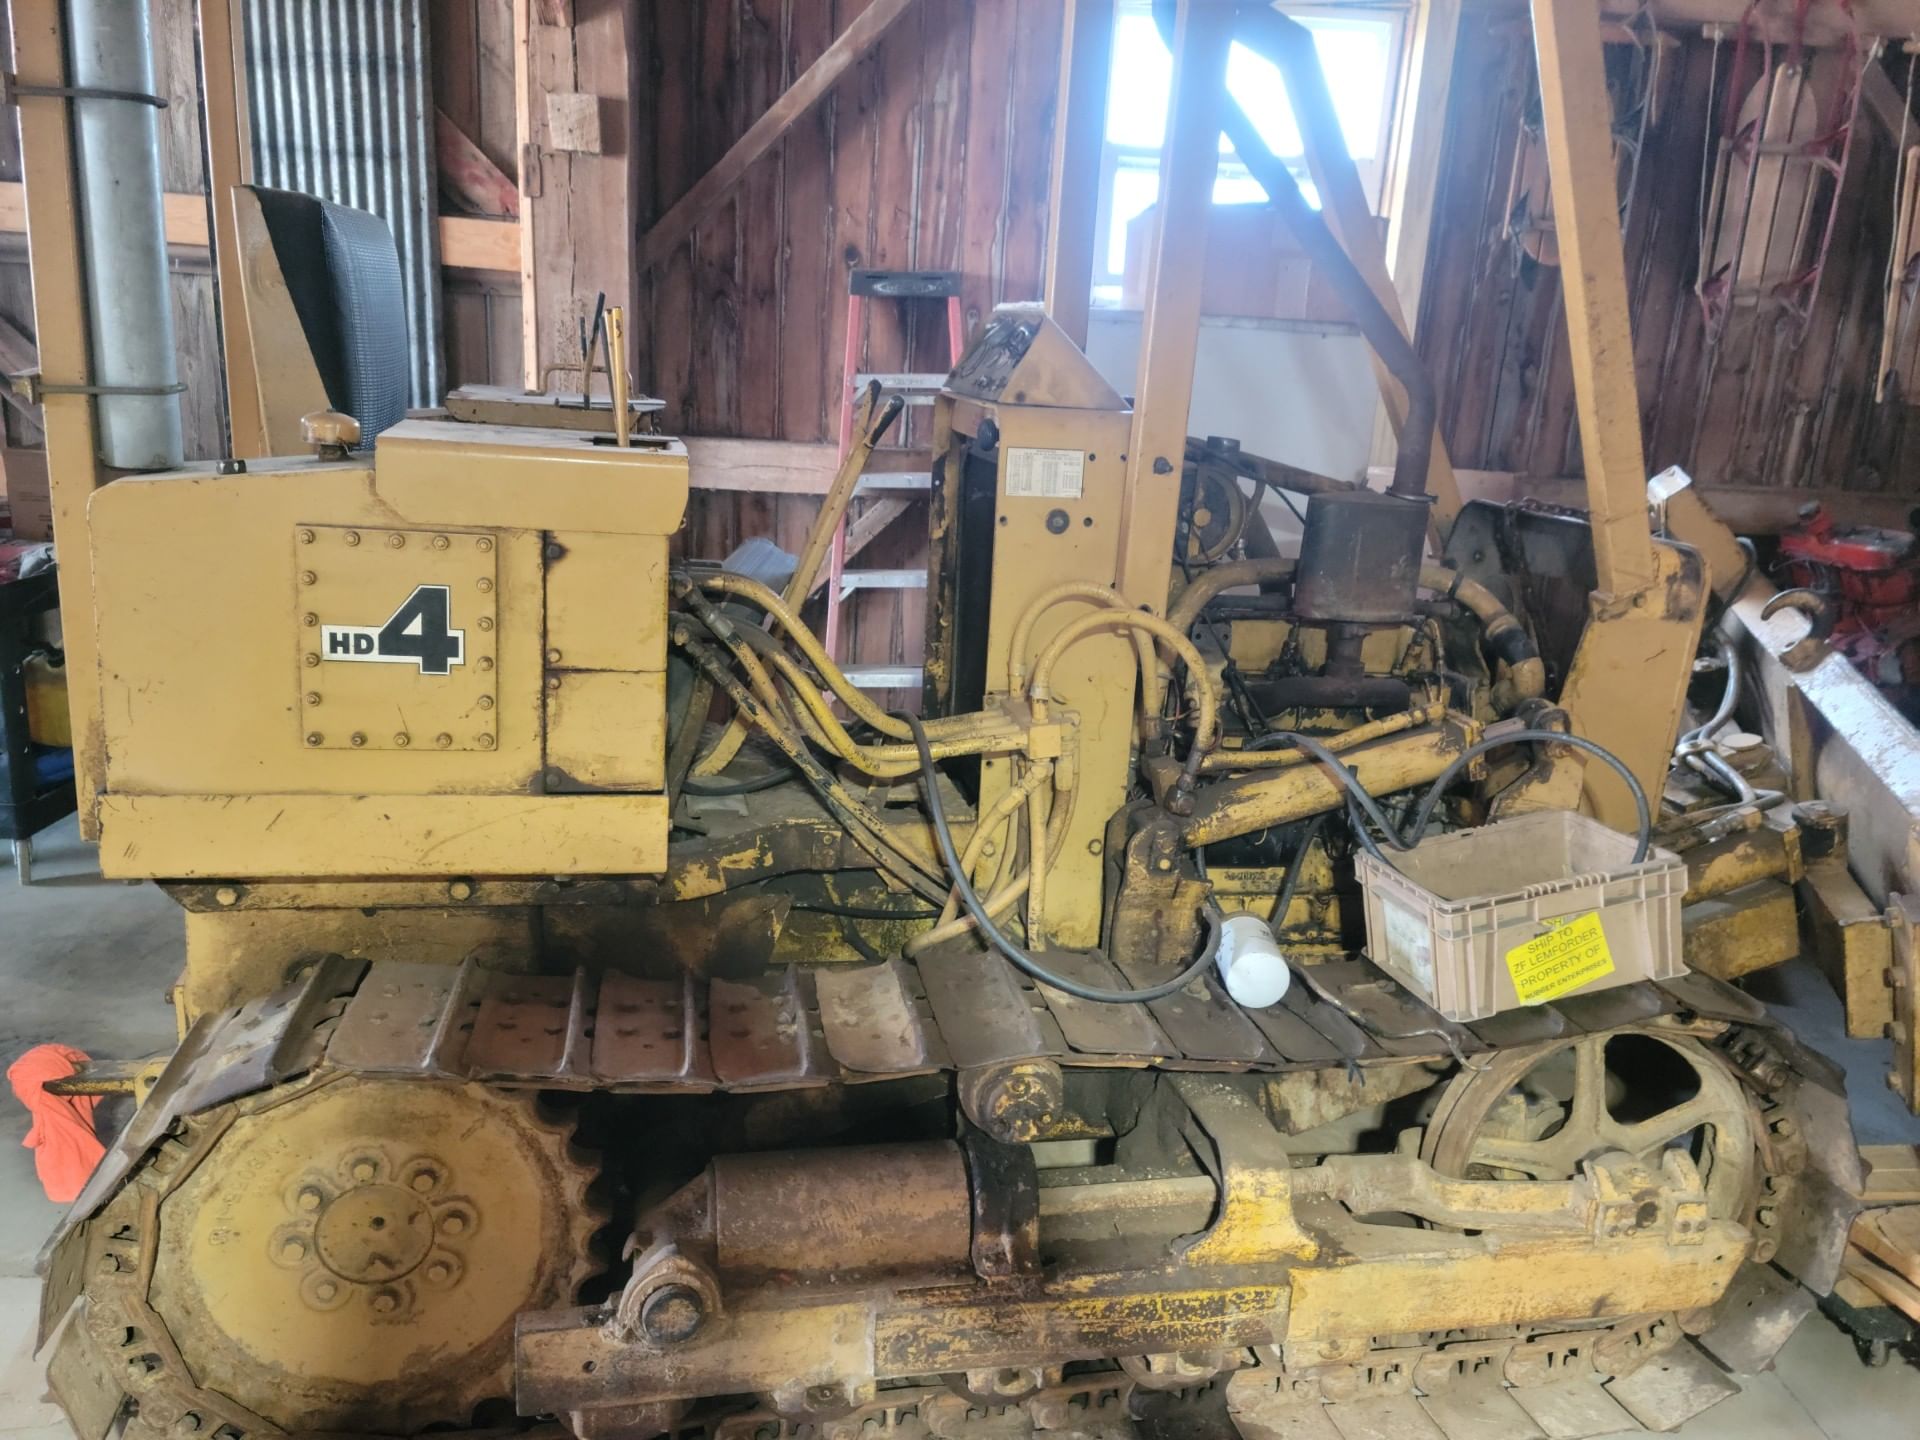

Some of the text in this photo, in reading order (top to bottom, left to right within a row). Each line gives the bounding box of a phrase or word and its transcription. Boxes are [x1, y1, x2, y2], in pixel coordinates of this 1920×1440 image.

[1513, 928, 1598, 975] ZF LEMFORDER
[1527, 927, 1573, 954] SHIP TO
[1520, 945, 1600, 989] PROPERTY OF
